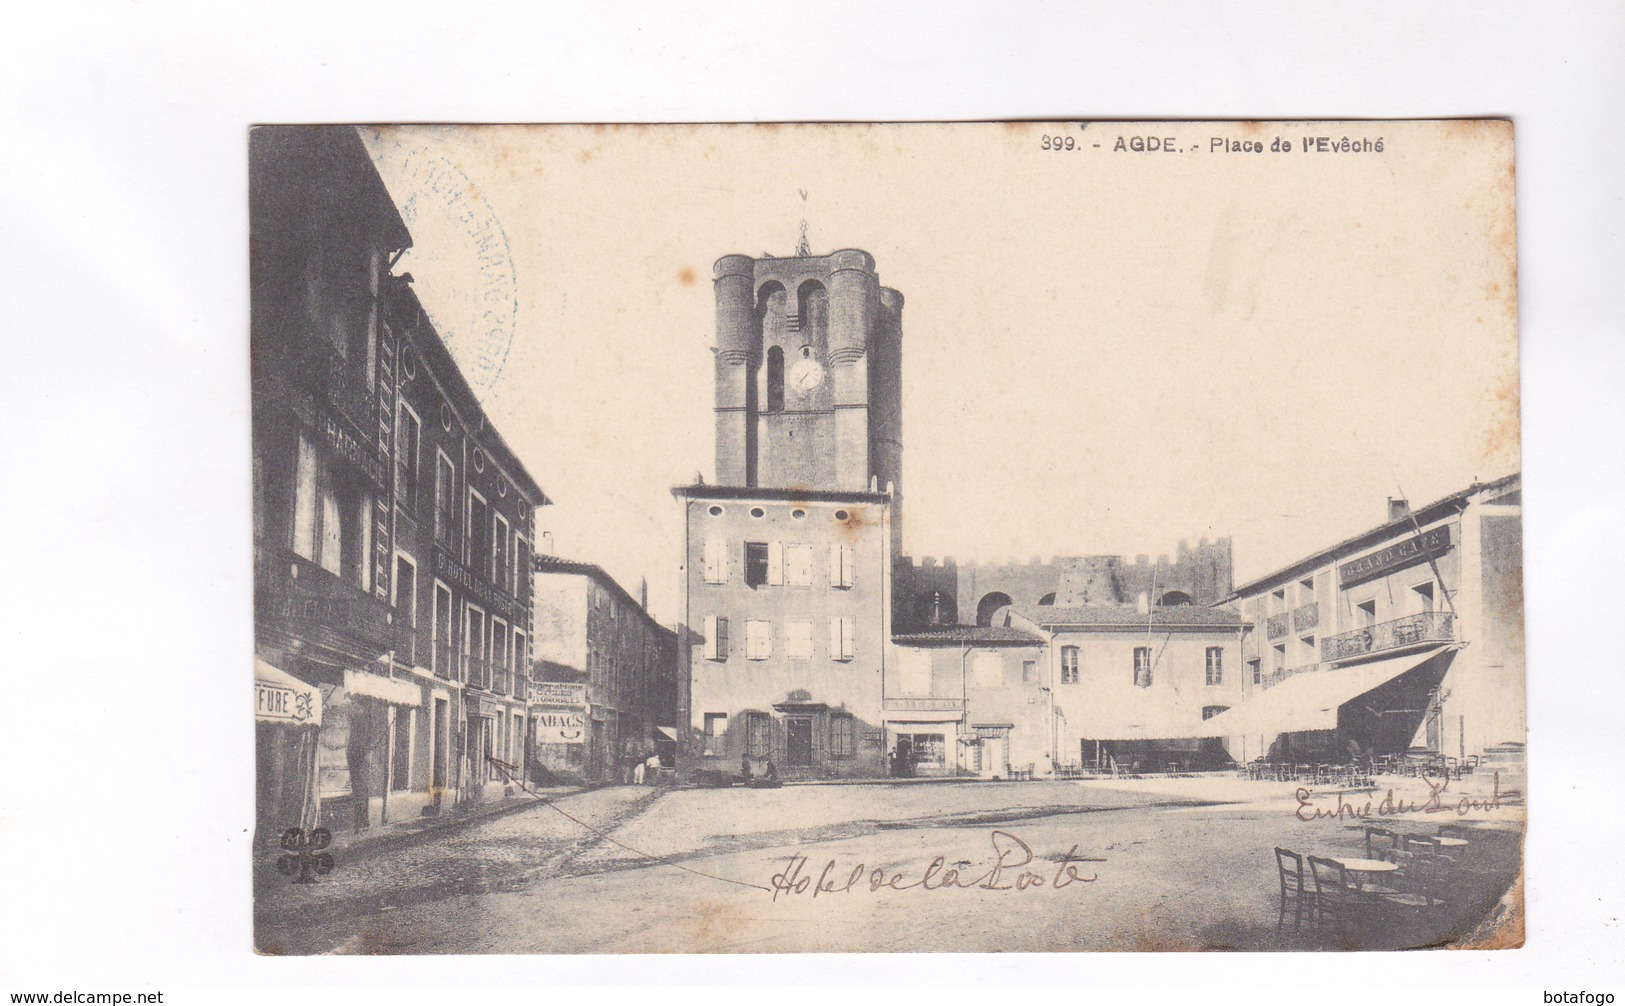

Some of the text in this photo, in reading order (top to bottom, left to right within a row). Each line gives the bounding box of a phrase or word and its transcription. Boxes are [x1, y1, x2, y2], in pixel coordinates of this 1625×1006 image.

[1343, 549, 1393, 577] GRAND
[448, 559, 472, 590] HOTEL
[474, 577, 484, 597] DE
[493, 591, 513, 616] POSTE
[254, 688, 289, 713] FURE
[869, 867, 911, 892] de
[978, 829, 1107, 892] Poste
